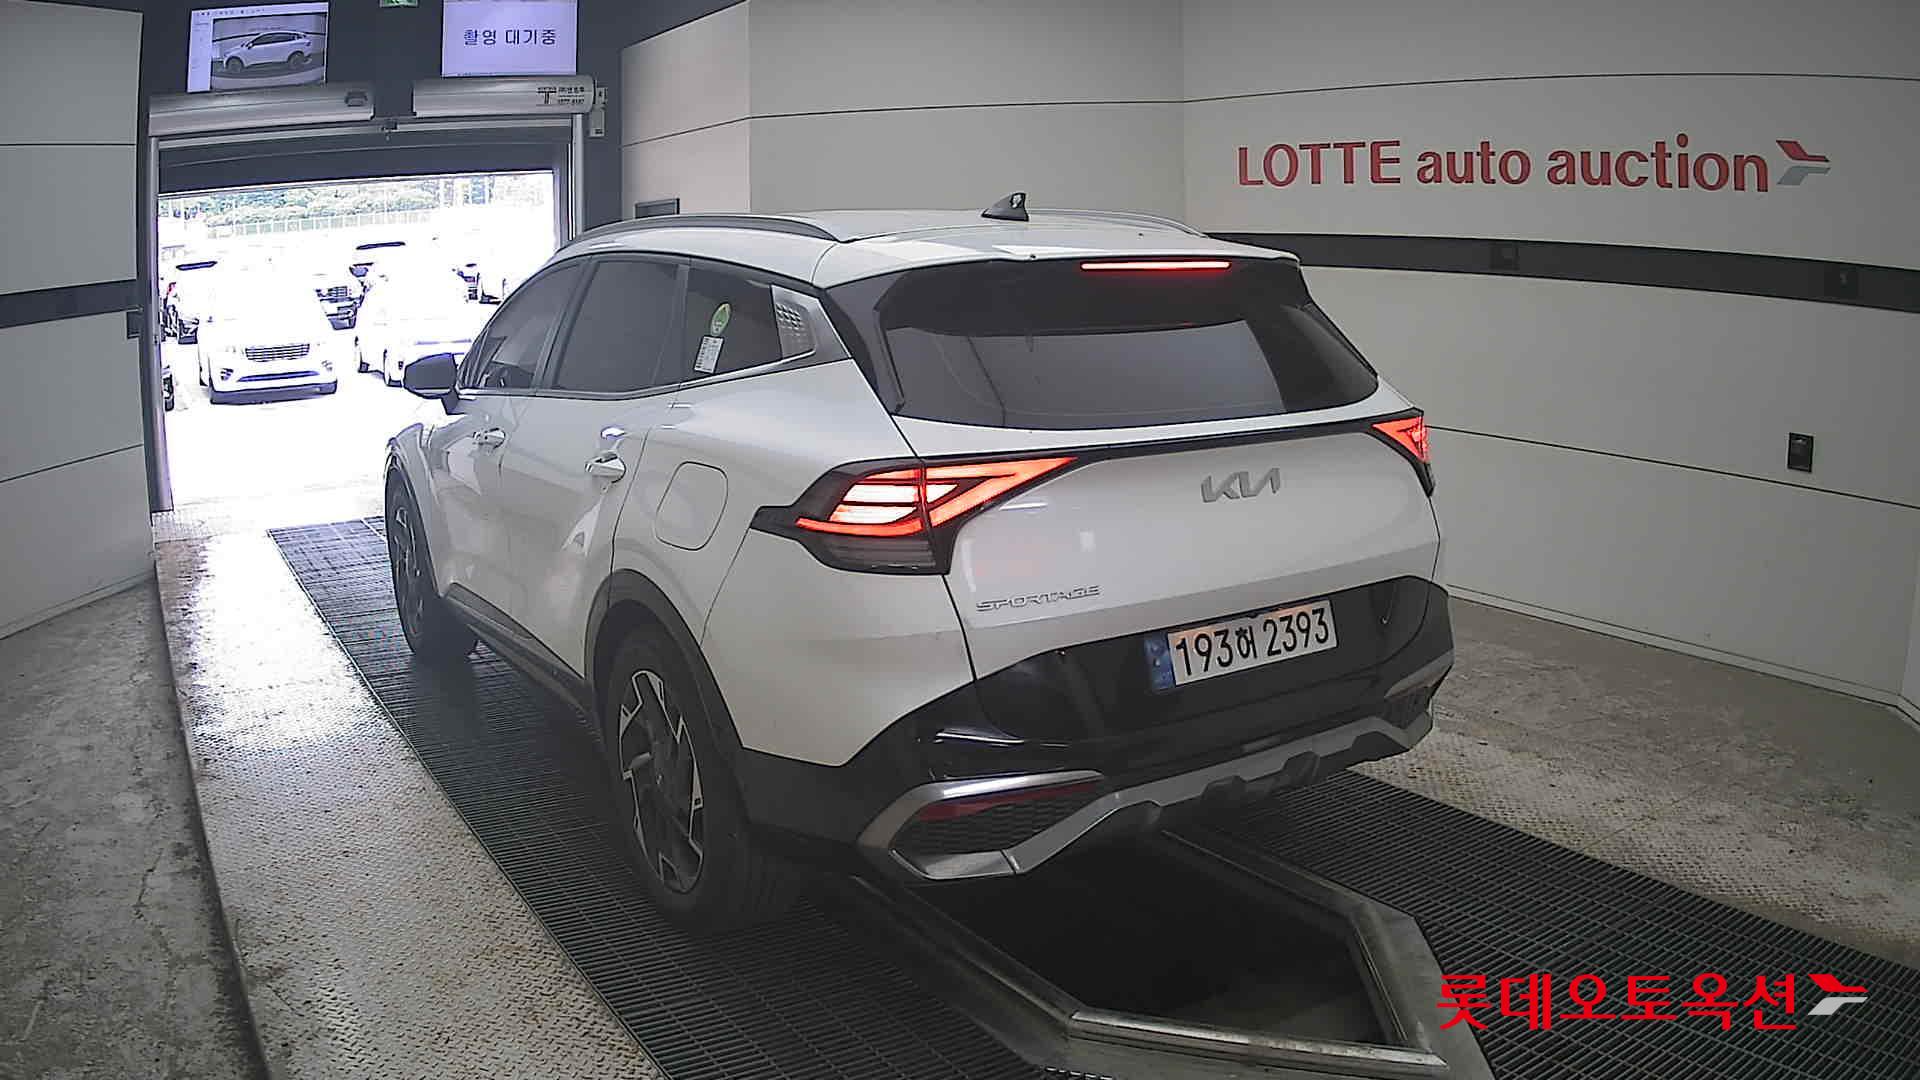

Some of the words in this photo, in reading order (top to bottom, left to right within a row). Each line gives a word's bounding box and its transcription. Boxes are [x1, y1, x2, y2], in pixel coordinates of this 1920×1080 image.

[505, 29, 556, 46] 대기중
[1238, 140, 1401, 187] LOTTE
[1416, 141, 1531, 185] auto
[1547, 132, 1768, 192] auction
[976, 584, 1101, 612] SPORTAGE
[1175, 625, 1258, 676] 193허
[1263, 607, 1330, 657] 2393
